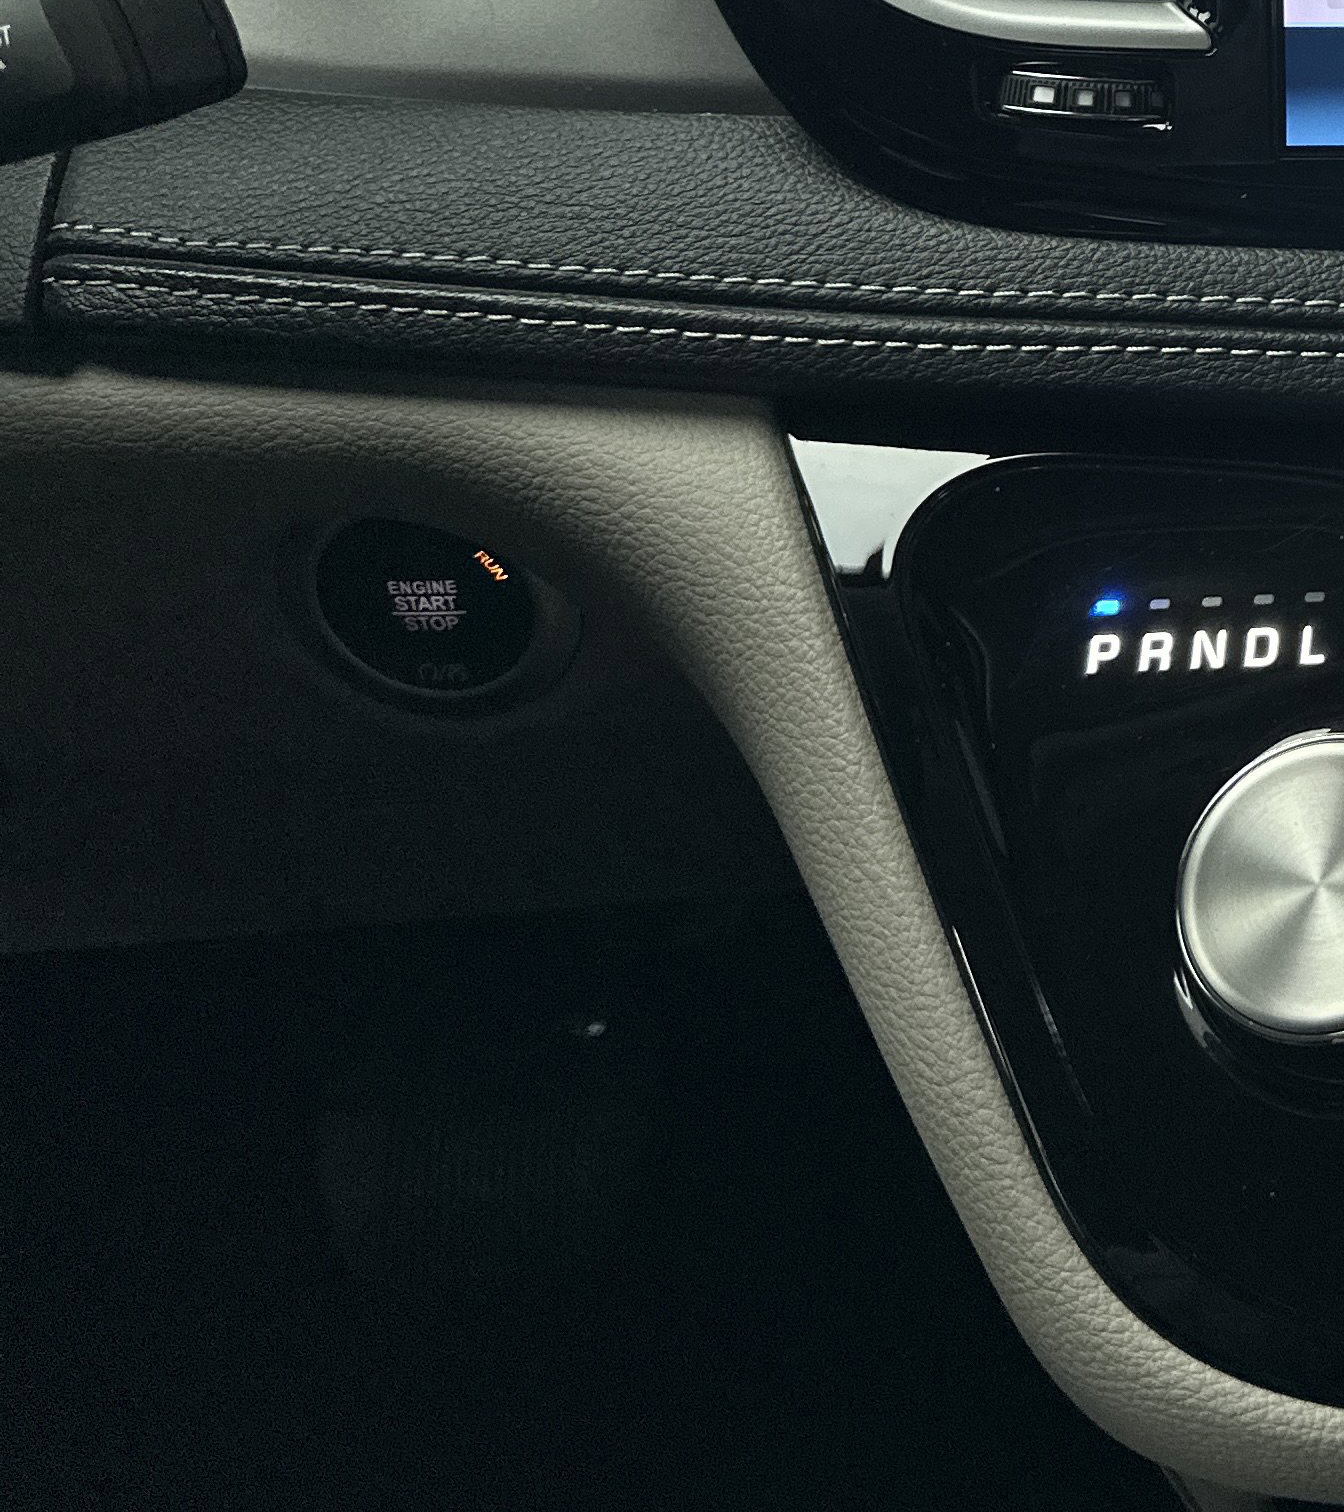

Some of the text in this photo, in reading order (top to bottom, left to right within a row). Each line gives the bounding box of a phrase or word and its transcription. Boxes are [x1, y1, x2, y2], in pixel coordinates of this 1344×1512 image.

[473, 550, 509, 581] RUN
[386, 579, 458, 595] ENGINE
[394, 595, 457, 611] START
[404, 615, 459, 631] STOP
